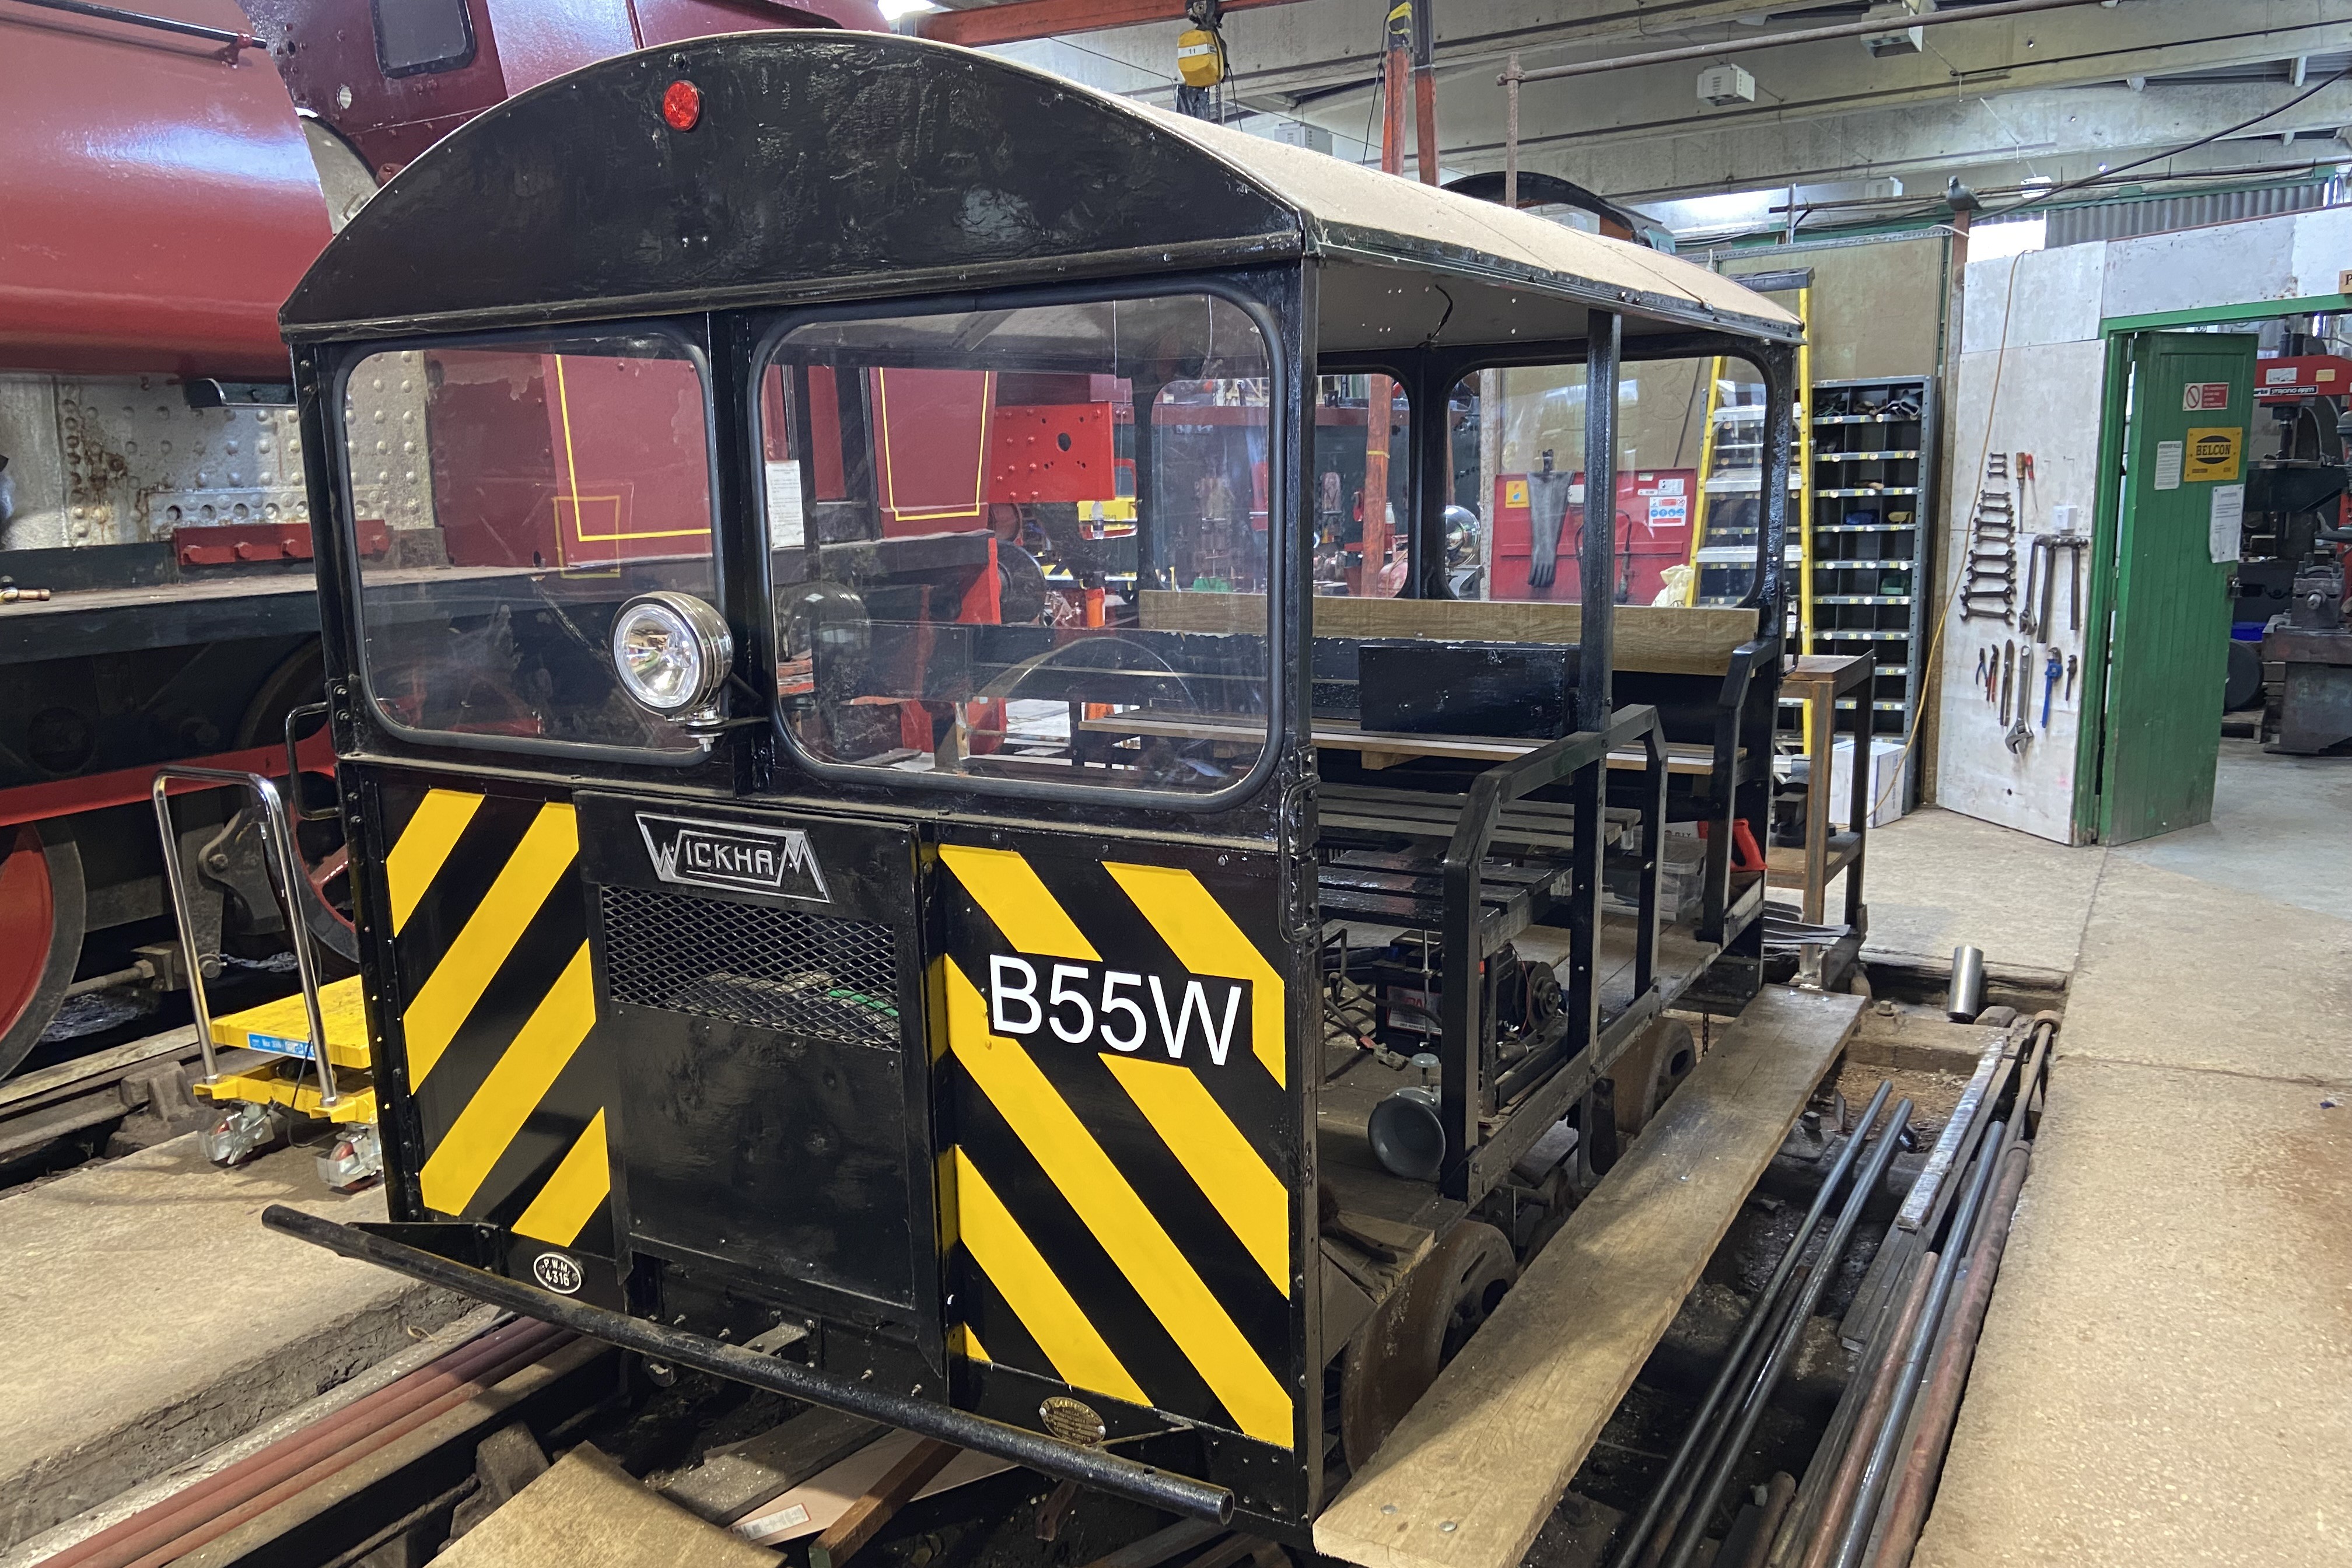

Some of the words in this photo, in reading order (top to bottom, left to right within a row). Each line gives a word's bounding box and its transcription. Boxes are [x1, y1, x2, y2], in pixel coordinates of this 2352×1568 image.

[2196, 444, 2231, 456] BELCON
[636, 813, 831, 903] WICKHAM
[990, 954, 1242, 1066] B55W
[545, 1269, 570, 1287] 4316
